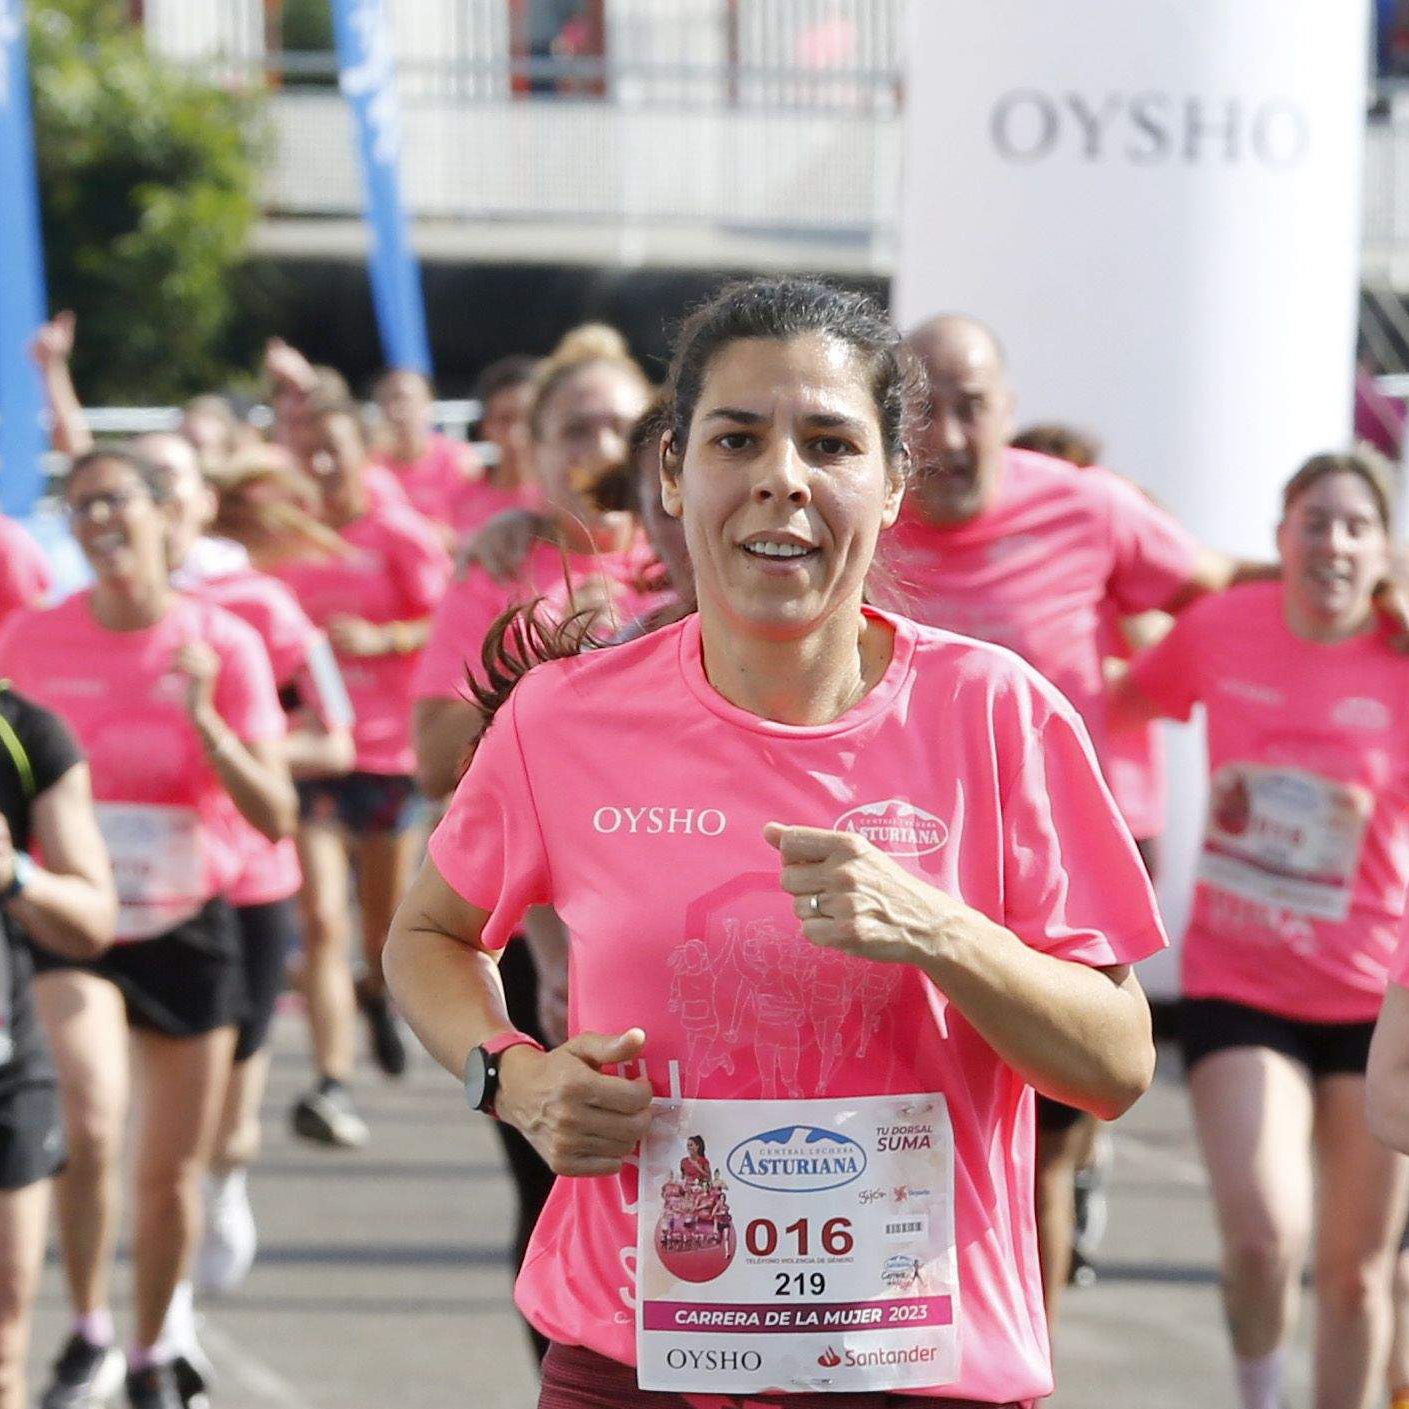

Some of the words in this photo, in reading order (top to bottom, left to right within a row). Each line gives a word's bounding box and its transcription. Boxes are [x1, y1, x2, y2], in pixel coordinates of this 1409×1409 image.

[988, 86, 1310, 168] OYSHO
[593, 806, 726, 836] OYSHO
[876, 1127, 889, 1135] TU
[891, 1125, 933, 1135] DORSAL
[759, 1148, 804, 1156] CENTRAL
[808, 1147, 854, 1156] LECHERA
[876, 1135, 932, 1151] SUMA
[738, 1150, 858, 1176] ASTURIANA
[745, 1217, 854, 1257] 016
[775, 1272, 826, 1296] 219
[674, 1309, 760, 1326] CARRERA
[765, 1310, 790, 1326] DE
[795, 1309, 819, 1326] LA
[823, 1306, 882, 1325] MUJER
[888, 1304, 928, 1322] 2023
[666, 1347, 762, 1371] OYSHO
[844, 1345, 938, 1367] Santander
